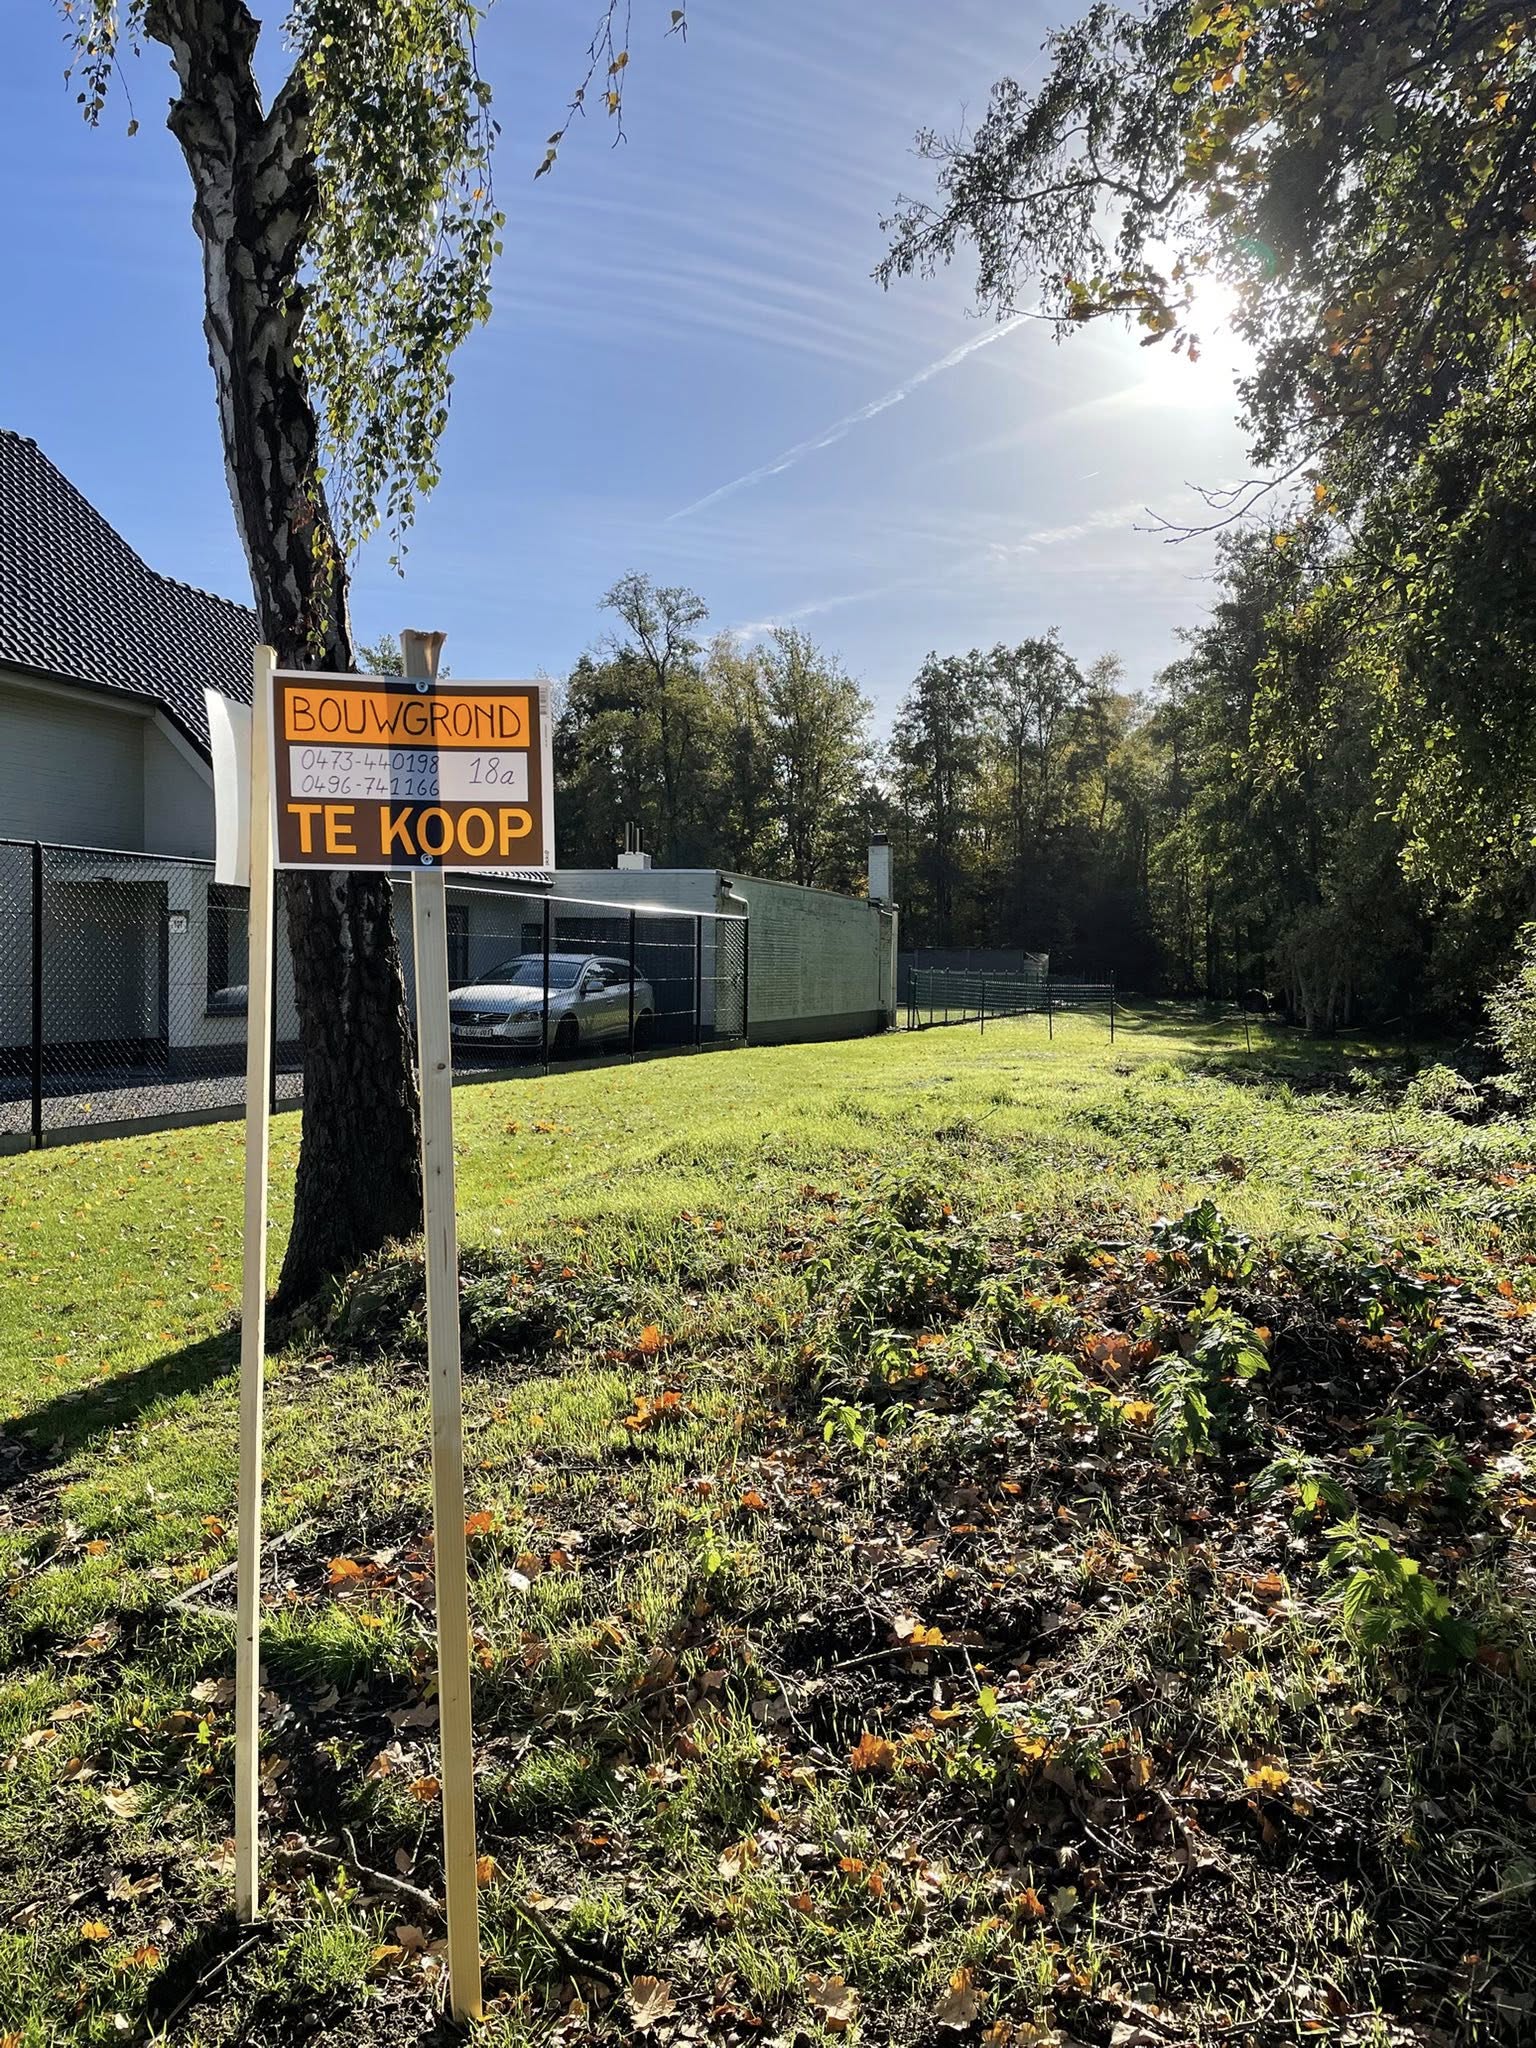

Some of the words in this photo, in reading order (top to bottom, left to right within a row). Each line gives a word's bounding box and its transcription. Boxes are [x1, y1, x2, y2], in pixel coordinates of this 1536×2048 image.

[293, 696, 521, 738] BOUWGROND
[301, 749, 439, 774] 0473-440198
[469, 757, 515, 784] 18a
[301, 775, 440, 796] 0496-741166
[287, 803, 357, 854] TE
[380, 806, 533, 856] KOOP
